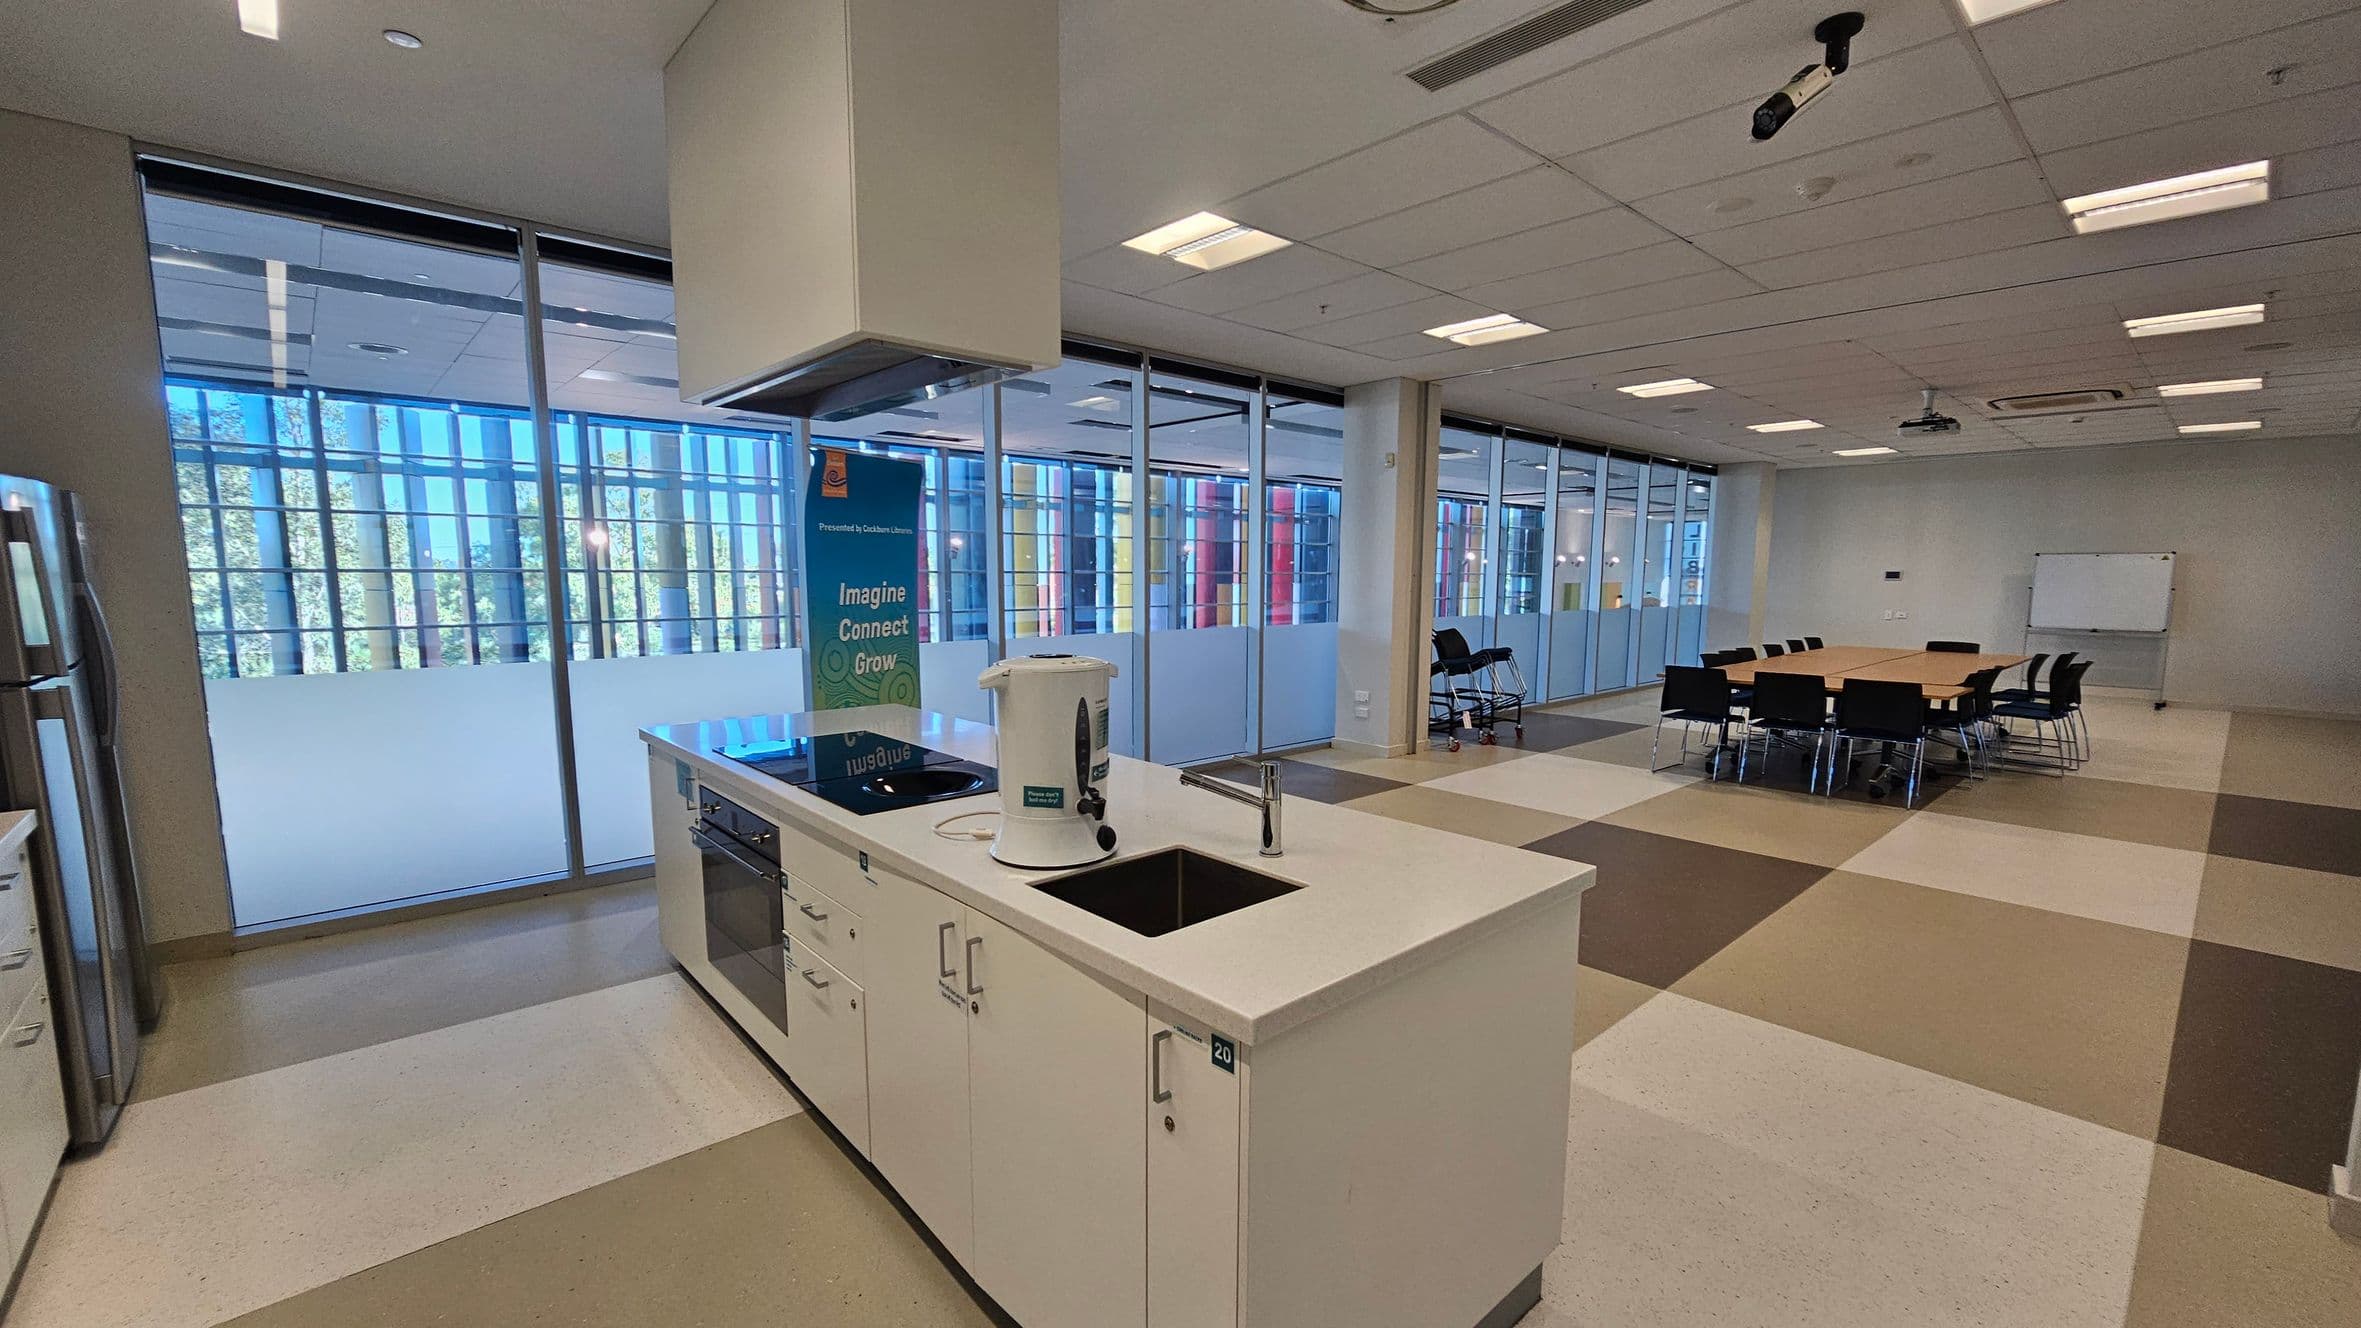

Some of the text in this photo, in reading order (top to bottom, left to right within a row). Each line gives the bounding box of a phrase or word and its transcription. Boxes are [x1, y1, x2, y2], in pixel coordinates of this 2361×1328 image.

[819, 522, 913, 535] Presented by Cockburn Libraries
[839, 580, 906, 610] Imagine
[839, 615, 909, 642] Connect
[855, 652, 897, 675] Grow
[1214, 1042, 1231, 1064] 20
